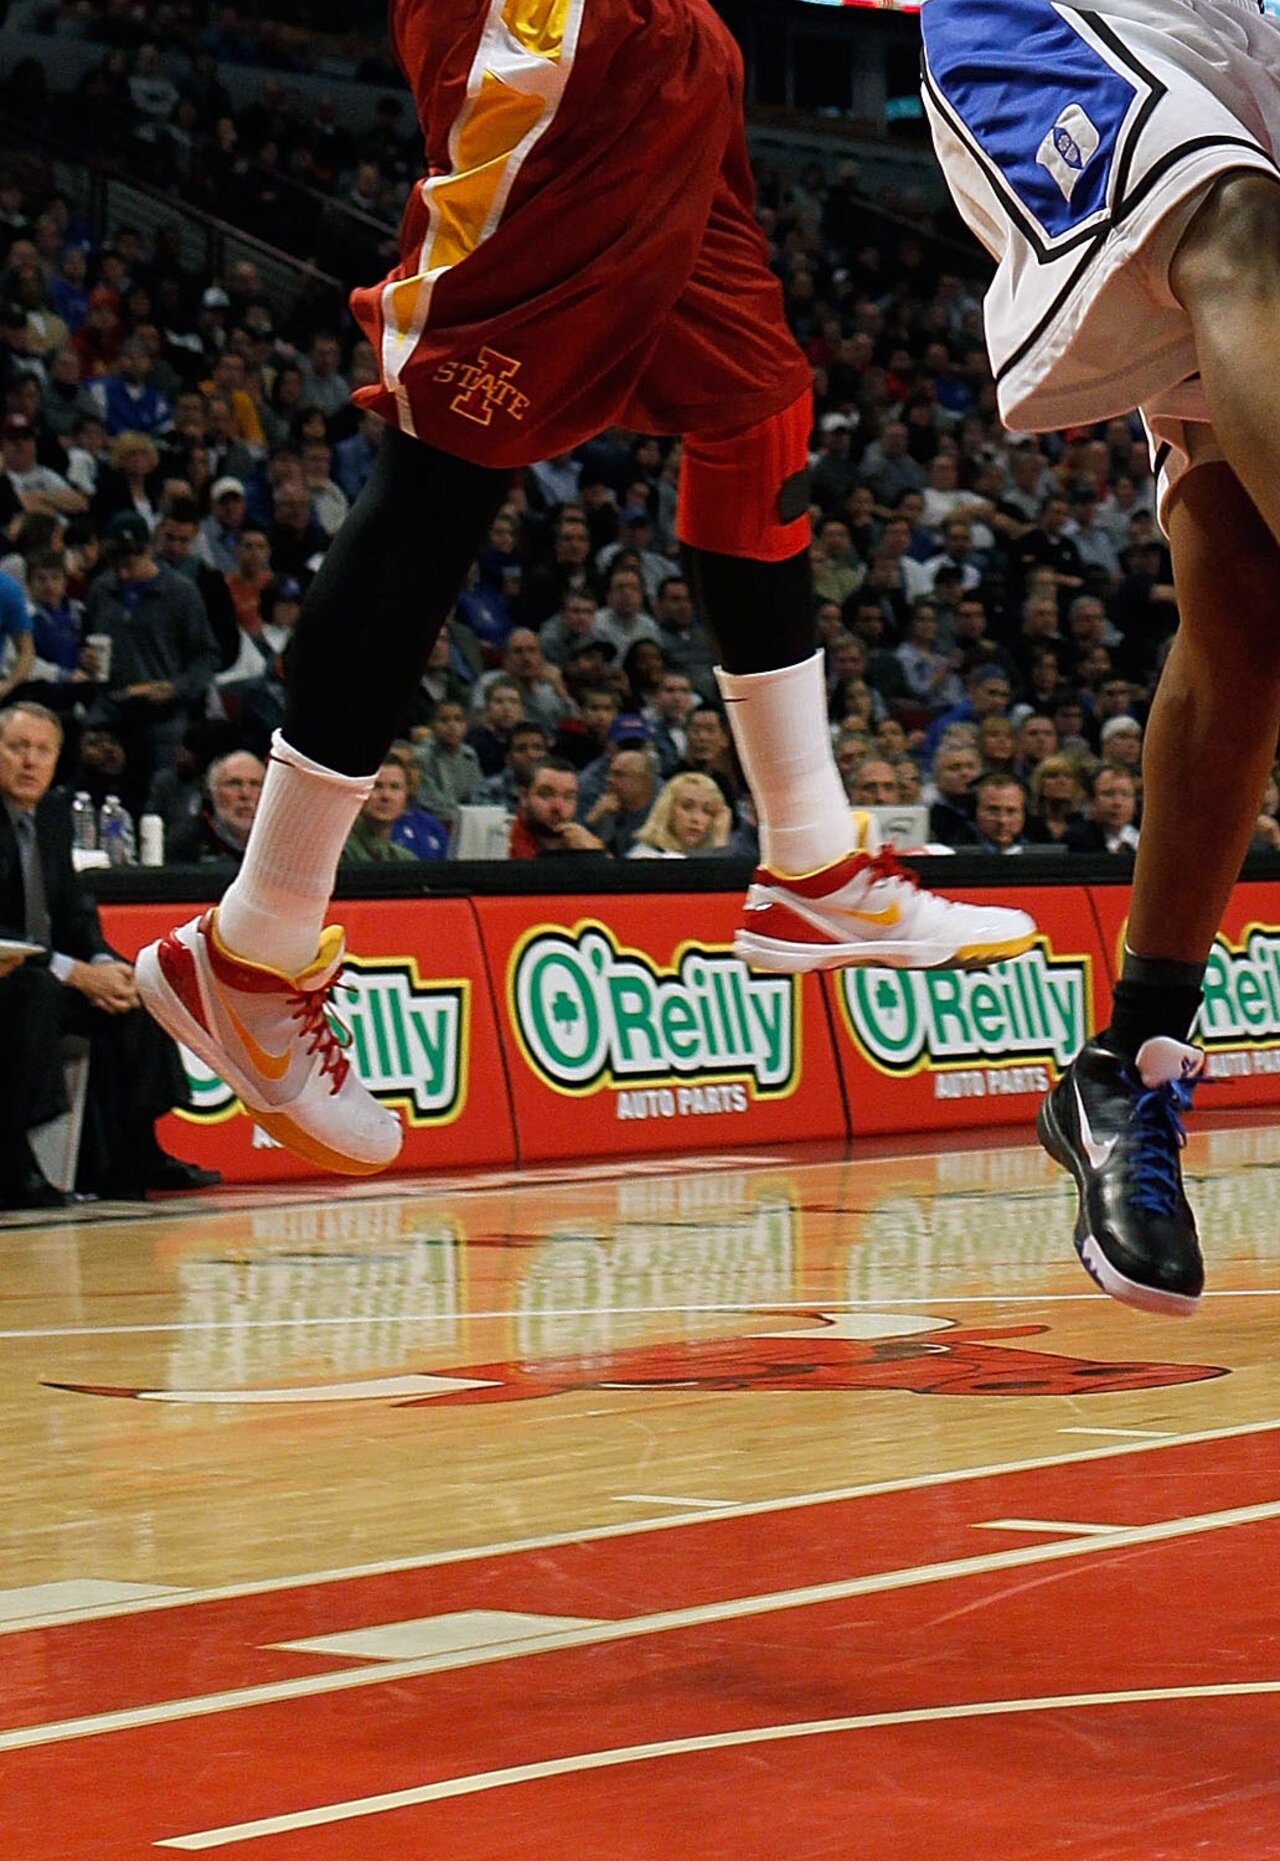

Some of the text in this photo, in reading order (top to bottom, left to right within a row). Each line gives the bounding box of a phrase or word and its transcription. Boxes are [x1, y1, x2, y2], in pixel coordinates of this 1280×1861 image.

[432, 361, 531, 421] STATE
[529, 947, 781, 1073] O'Reilly
[855, 961, 1075, 1056] OReilly
[616, 1083, 748, 1120] AUTO PARTS
